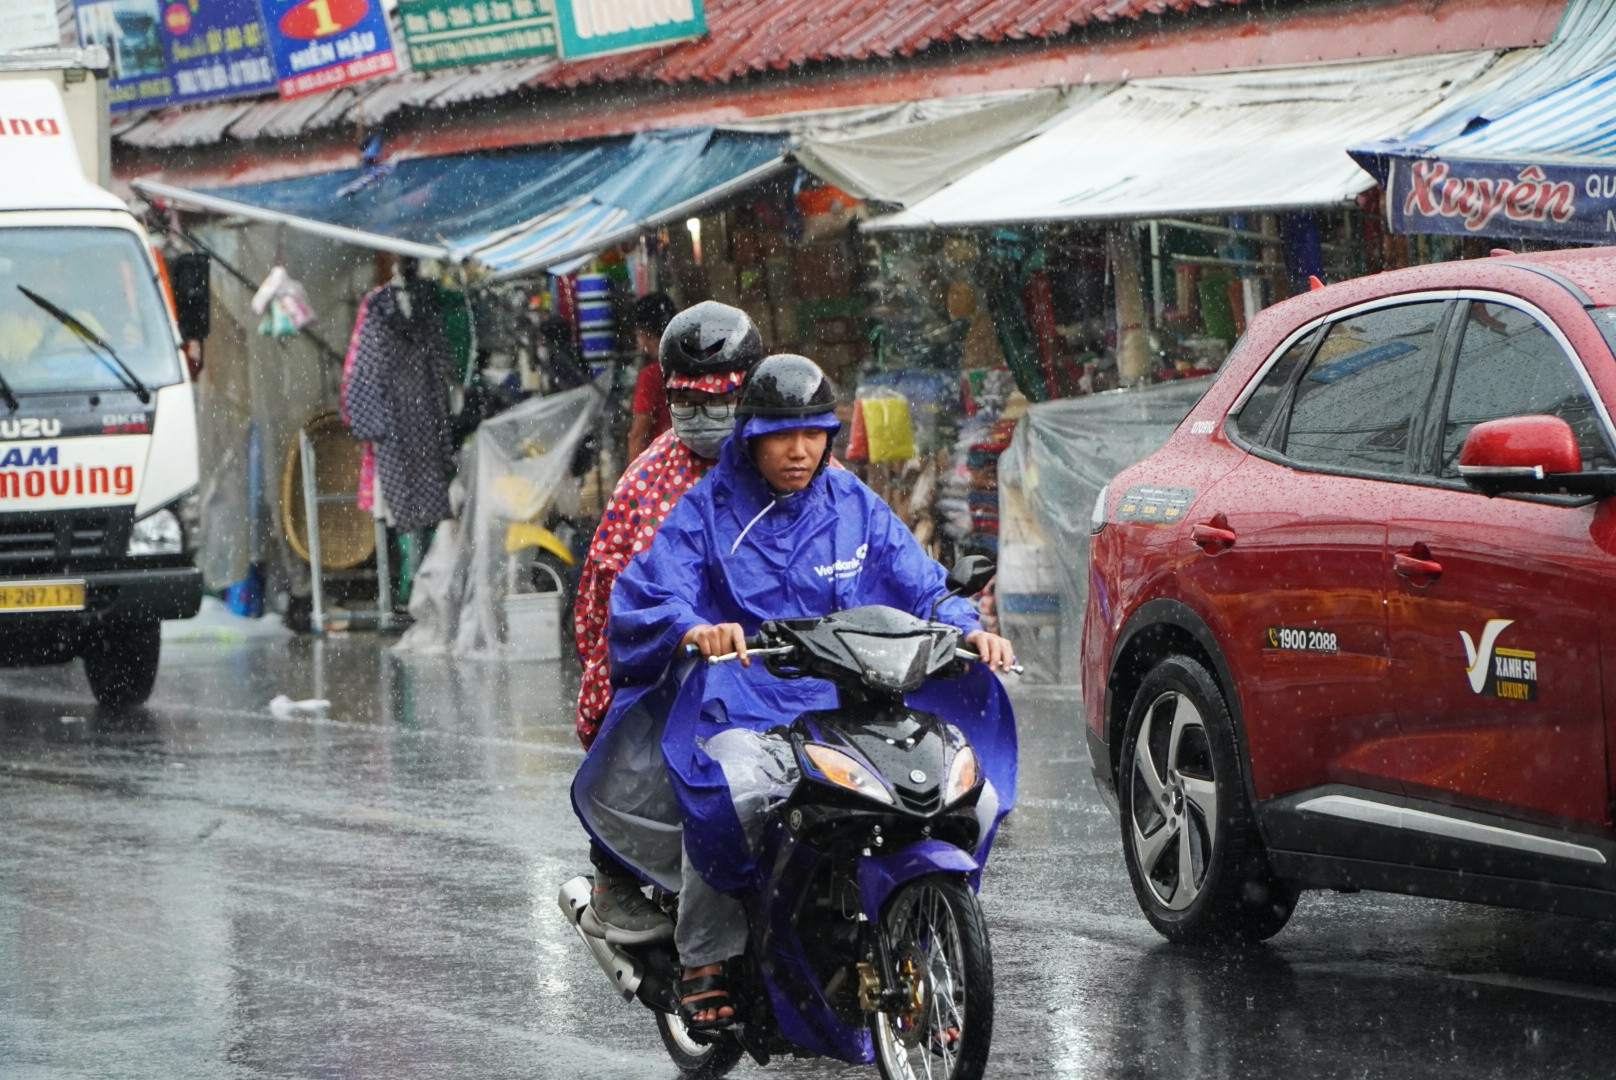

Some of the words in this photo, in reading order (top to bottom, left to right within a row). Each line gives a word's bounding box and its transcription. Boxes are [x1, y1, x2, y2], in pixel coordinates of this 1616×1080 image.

[1404, 160, 1576, 231] Xuyên
[0, 418, 60, 438] UZU
[1280, 628, 1307, 649] 1900
[1308, 631, 1337, 651] 2088
[1495, 656, 1522, 679] XANH
[1496, 680, 1529, 700] LUXURY
